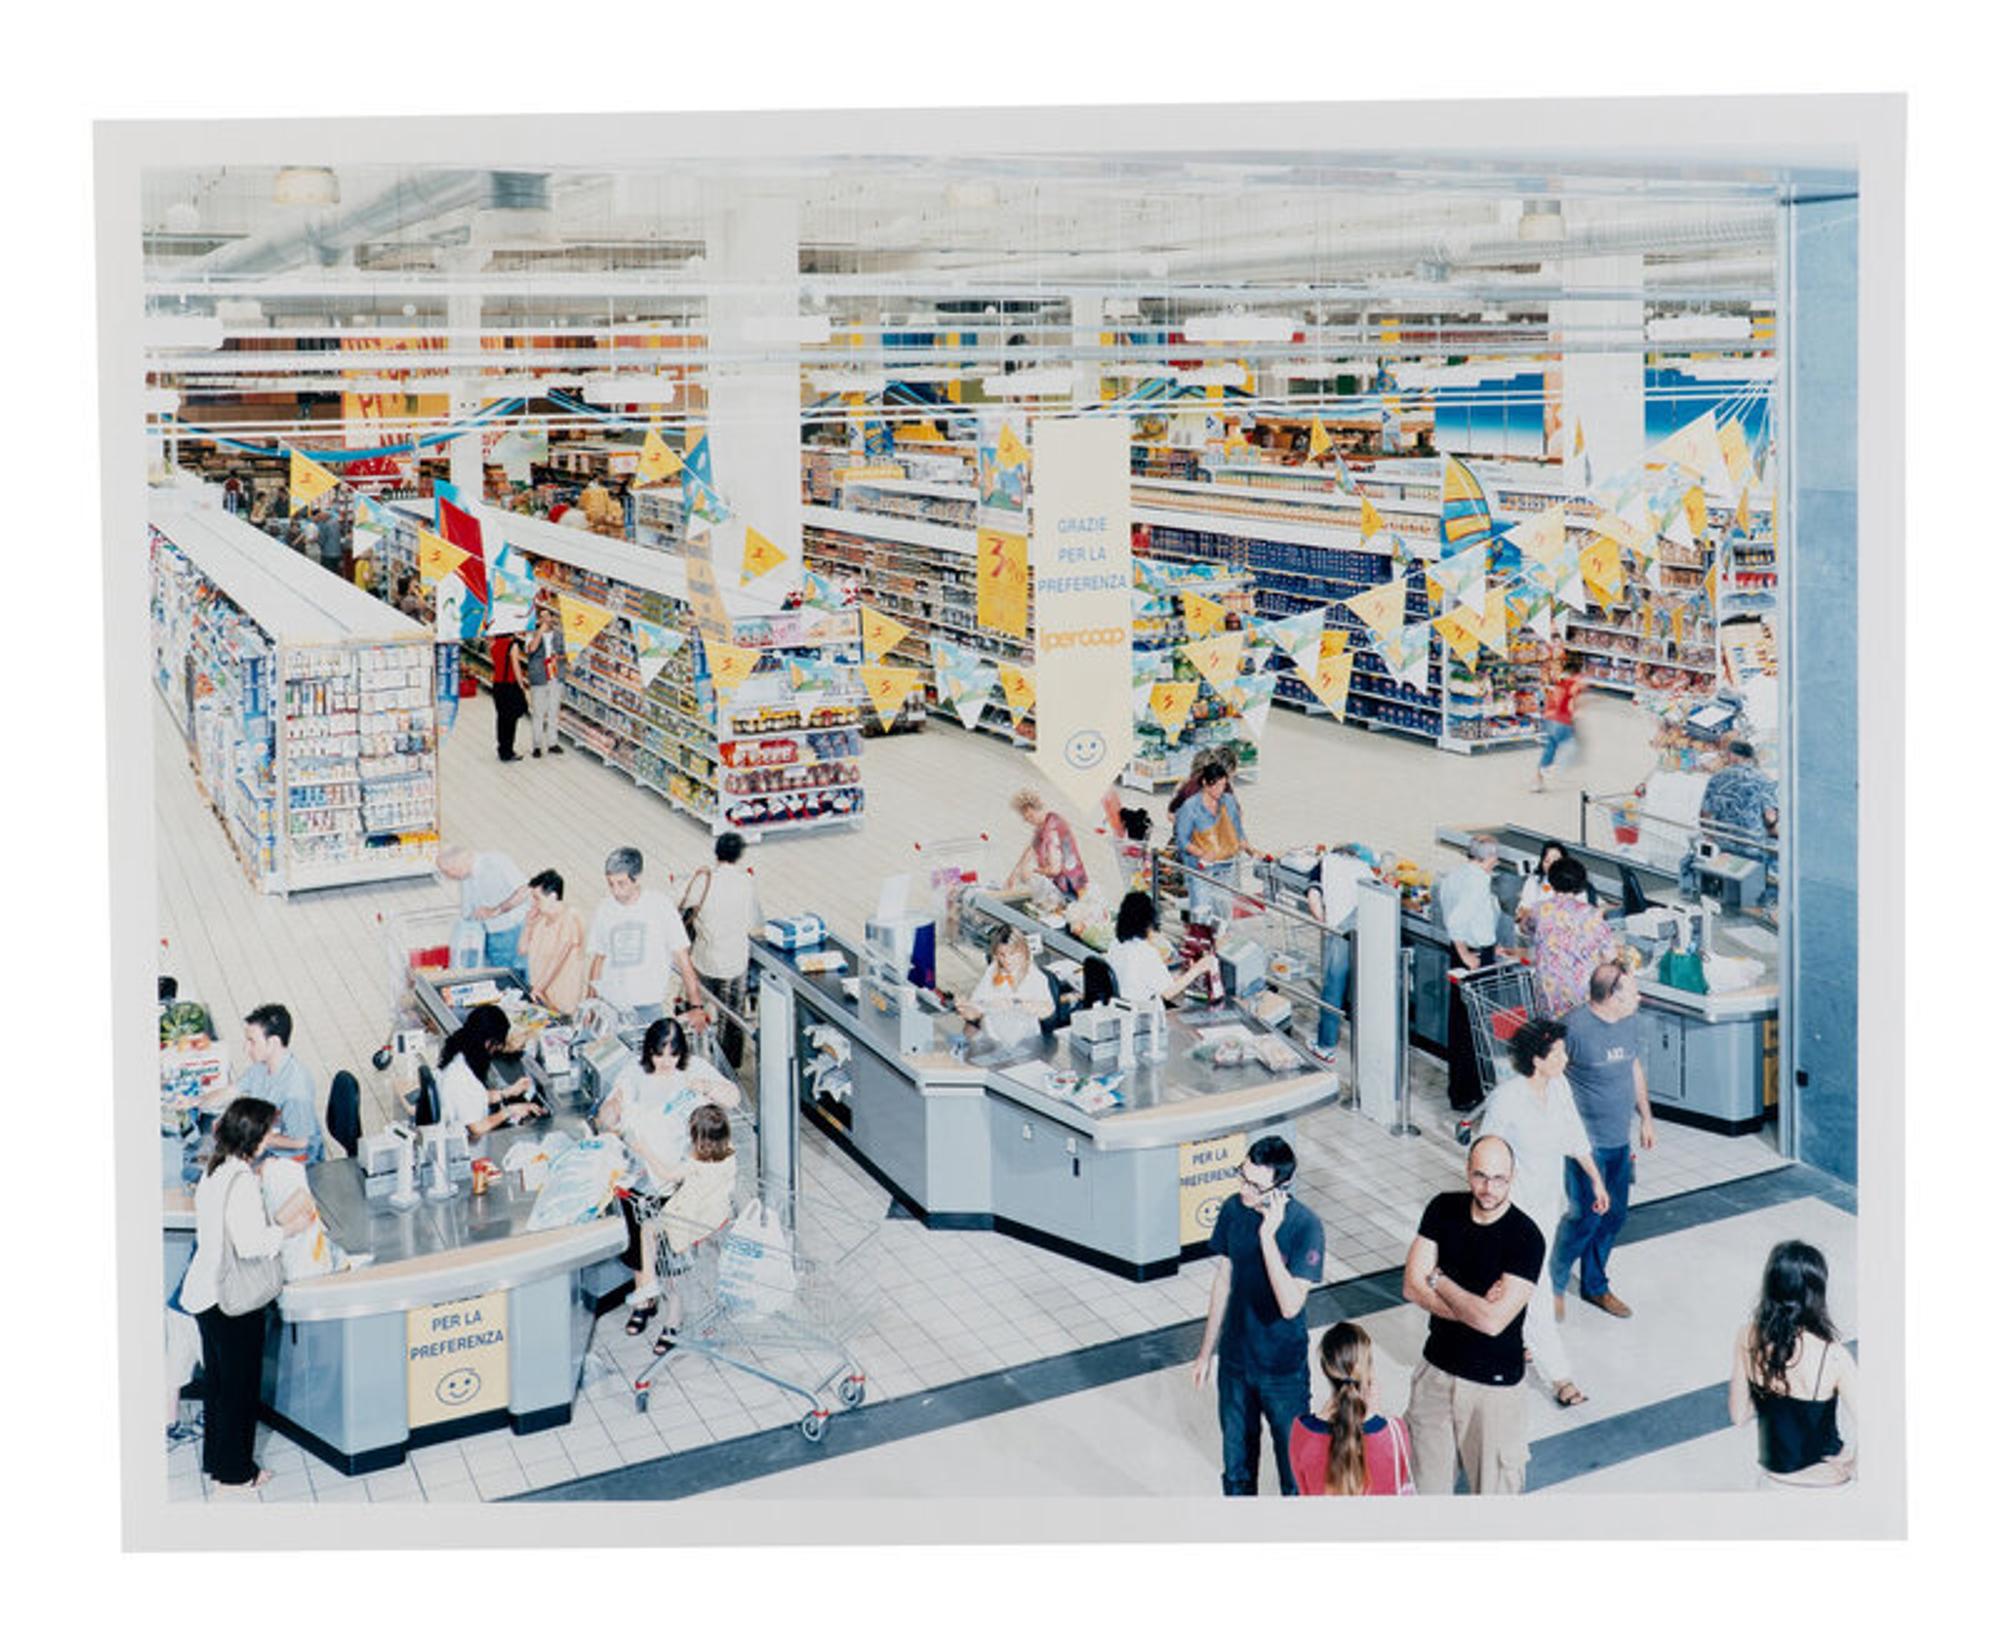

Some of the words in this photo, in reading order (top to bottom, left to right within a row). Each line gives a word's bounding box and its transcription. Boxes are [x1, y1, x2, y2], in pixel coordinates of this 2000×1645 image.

[1057, 516, 1107, 533] GRAZIE
[1059, 548, 1086, 562] PER
[1090, 547, 1107, 561] LA
[1037, 574, 1127, 593] PREFERENZA
[1191, 1150, 1214, 1165] PER
[1215, 1148, 1228, 1161] LA
[432, 1313, 461, 1332] PER
[464, 1309, 482, 1326] LA
[410, 1329, 504, 1361] PREFERENZA
